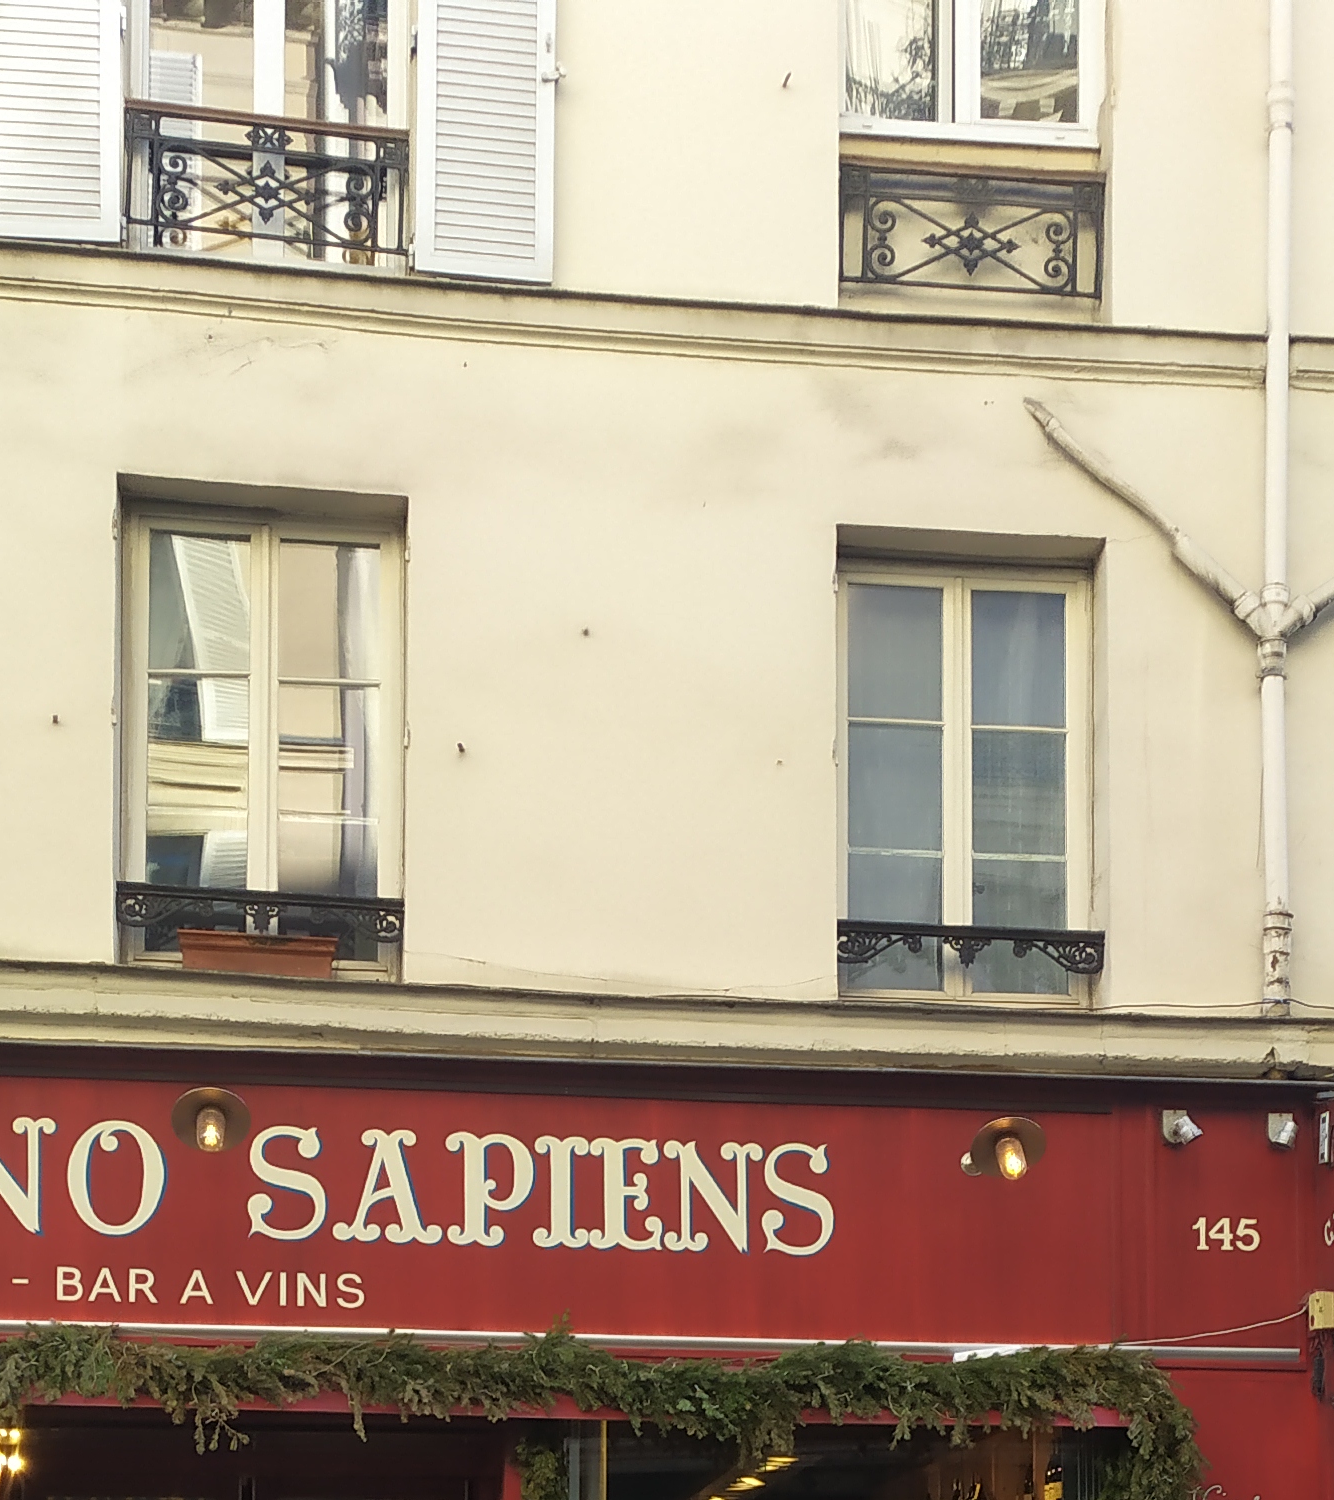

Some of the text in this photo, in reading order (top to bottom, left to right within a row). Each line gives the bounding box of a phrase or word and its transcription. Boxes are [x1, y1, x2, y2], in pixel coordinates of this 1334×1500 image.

[247, 1124, 836, 1257] SAPIENS
[1192, 1217, 1261, 1251] 145
[55, 1266, 158, 1304] BAR
[179, 1270, 214, 1305] A
[235, 1271, 366, 1309] VINS
